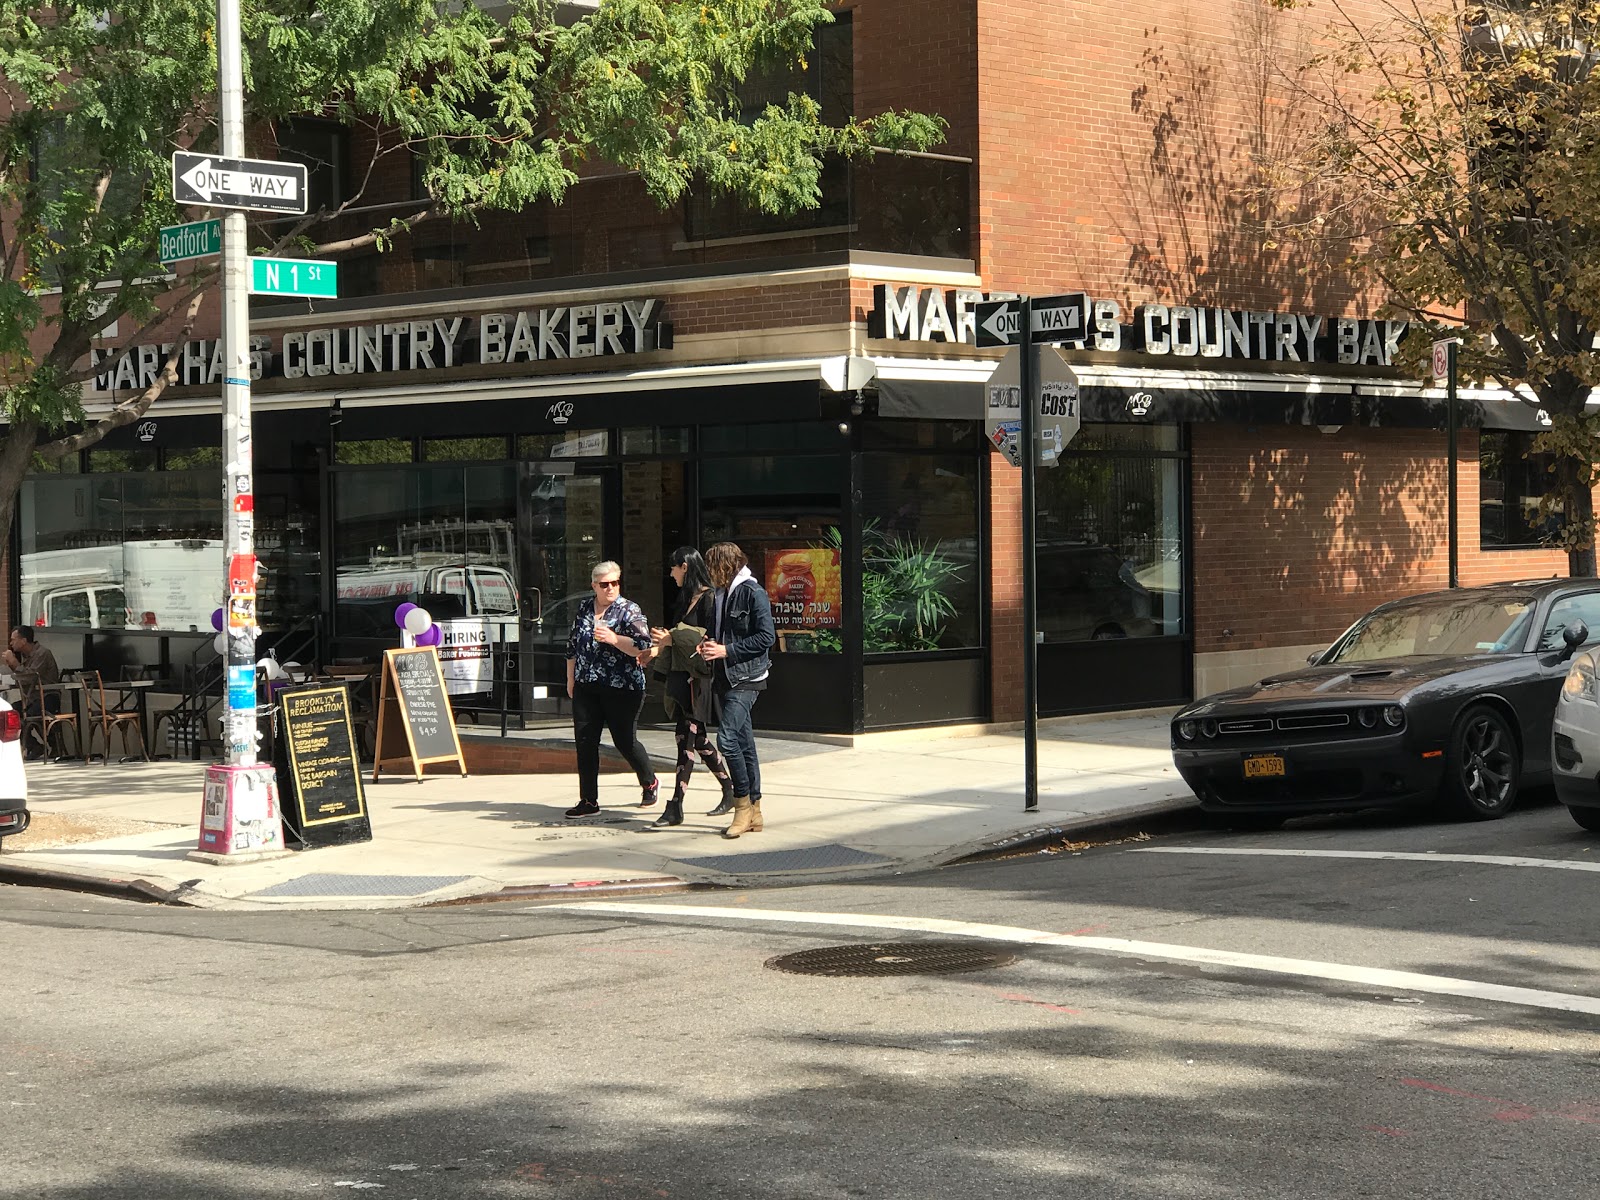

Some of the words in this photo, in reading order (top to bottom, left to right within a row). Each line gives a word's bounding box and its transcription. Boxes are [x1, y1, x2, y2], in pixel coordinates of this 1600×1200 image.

[195, 170, 231, 191] ONE
[249, 175, 289, 197] WAY
[162, 223, 209, 260] Bedford
[266, 263, 280, 290] N
[290, 265, 298, 291] 1
[308, 265, 321, 280] St
[1040, 308, 1073, 329] WAY
[283, 317, 464, 379] COUNTRY
[480, 299, 656, 365] BAKERY
[1143, 303, 1322, 362] COUNTRY
[1041, 393, 1077, 417] COST
[444, 630, 487, 645] HIRING
[437, 650, 458, 659] Baker
[458, 646, 489, 658] Positions
[290, 701, 343, 717] RECLAMATION
[294, 694, 336, 709] BROOKLYN
[1265, 758, 1282, 772] 1593
